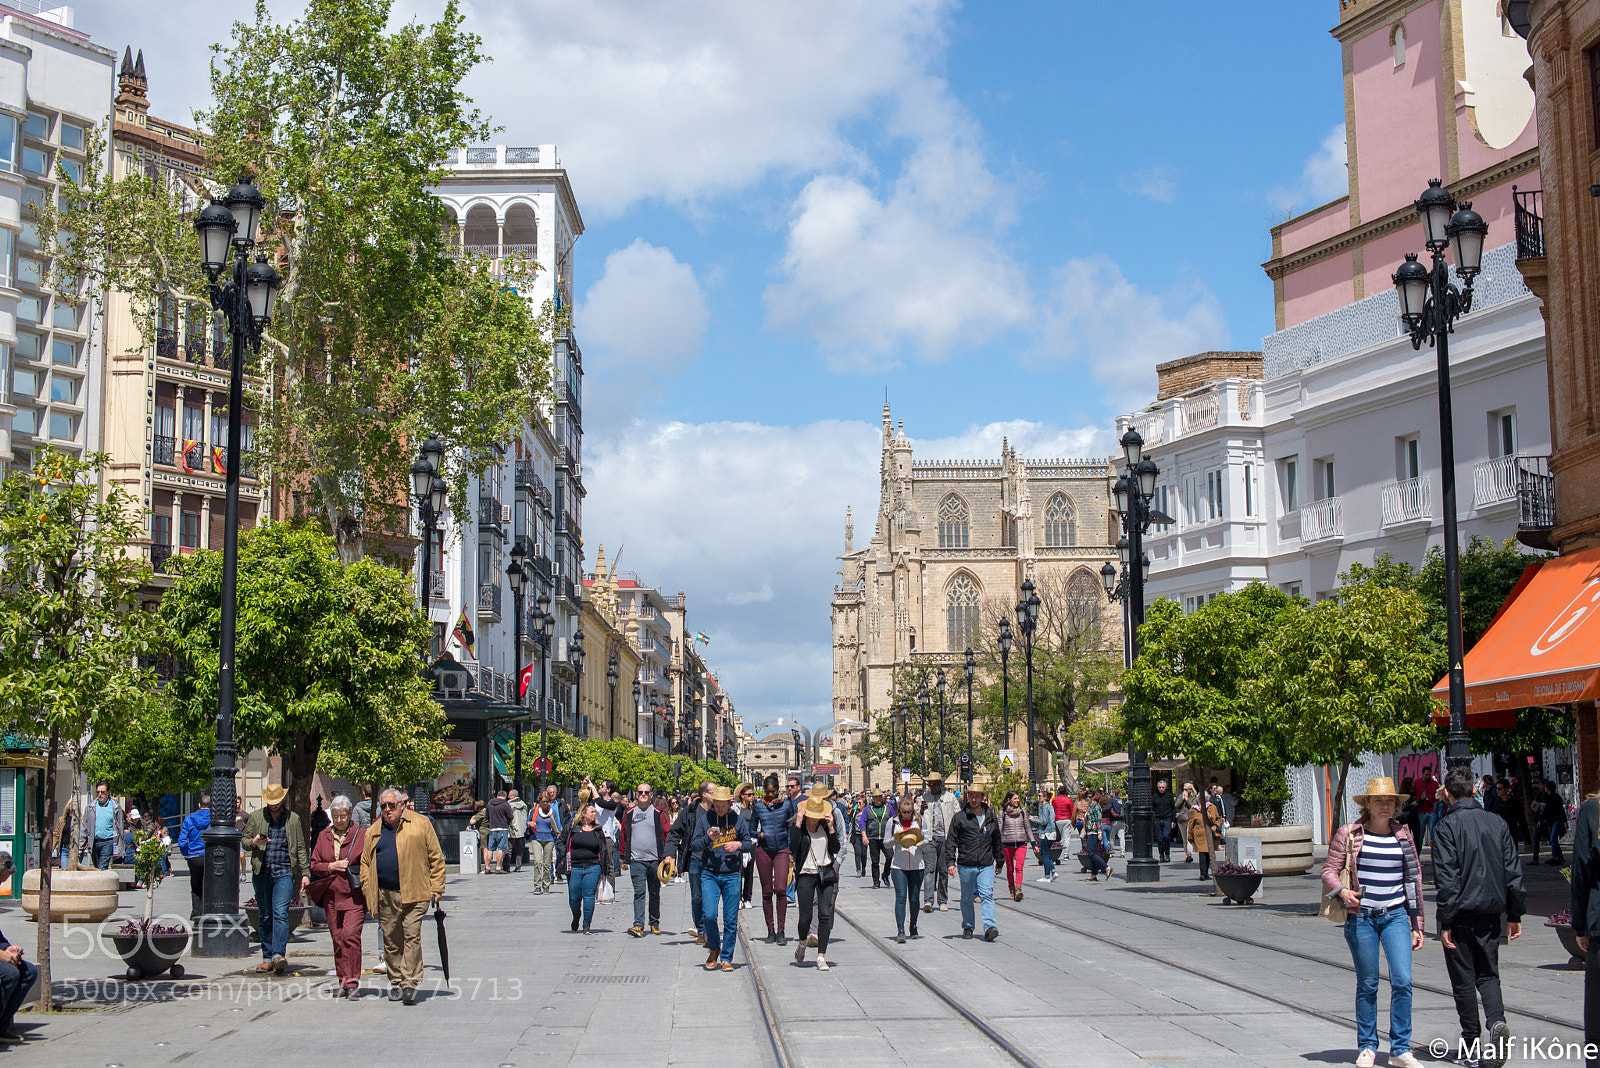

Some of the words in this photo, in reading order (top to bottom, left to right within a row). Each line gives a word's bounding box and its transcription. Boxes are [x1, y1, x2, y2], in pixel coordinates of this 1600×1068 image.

[1534, 684, 1554, 697] OFICINA
[1555, 683, 1562, 694] DE
[1563, 680, 1586, 693] TURISMO
